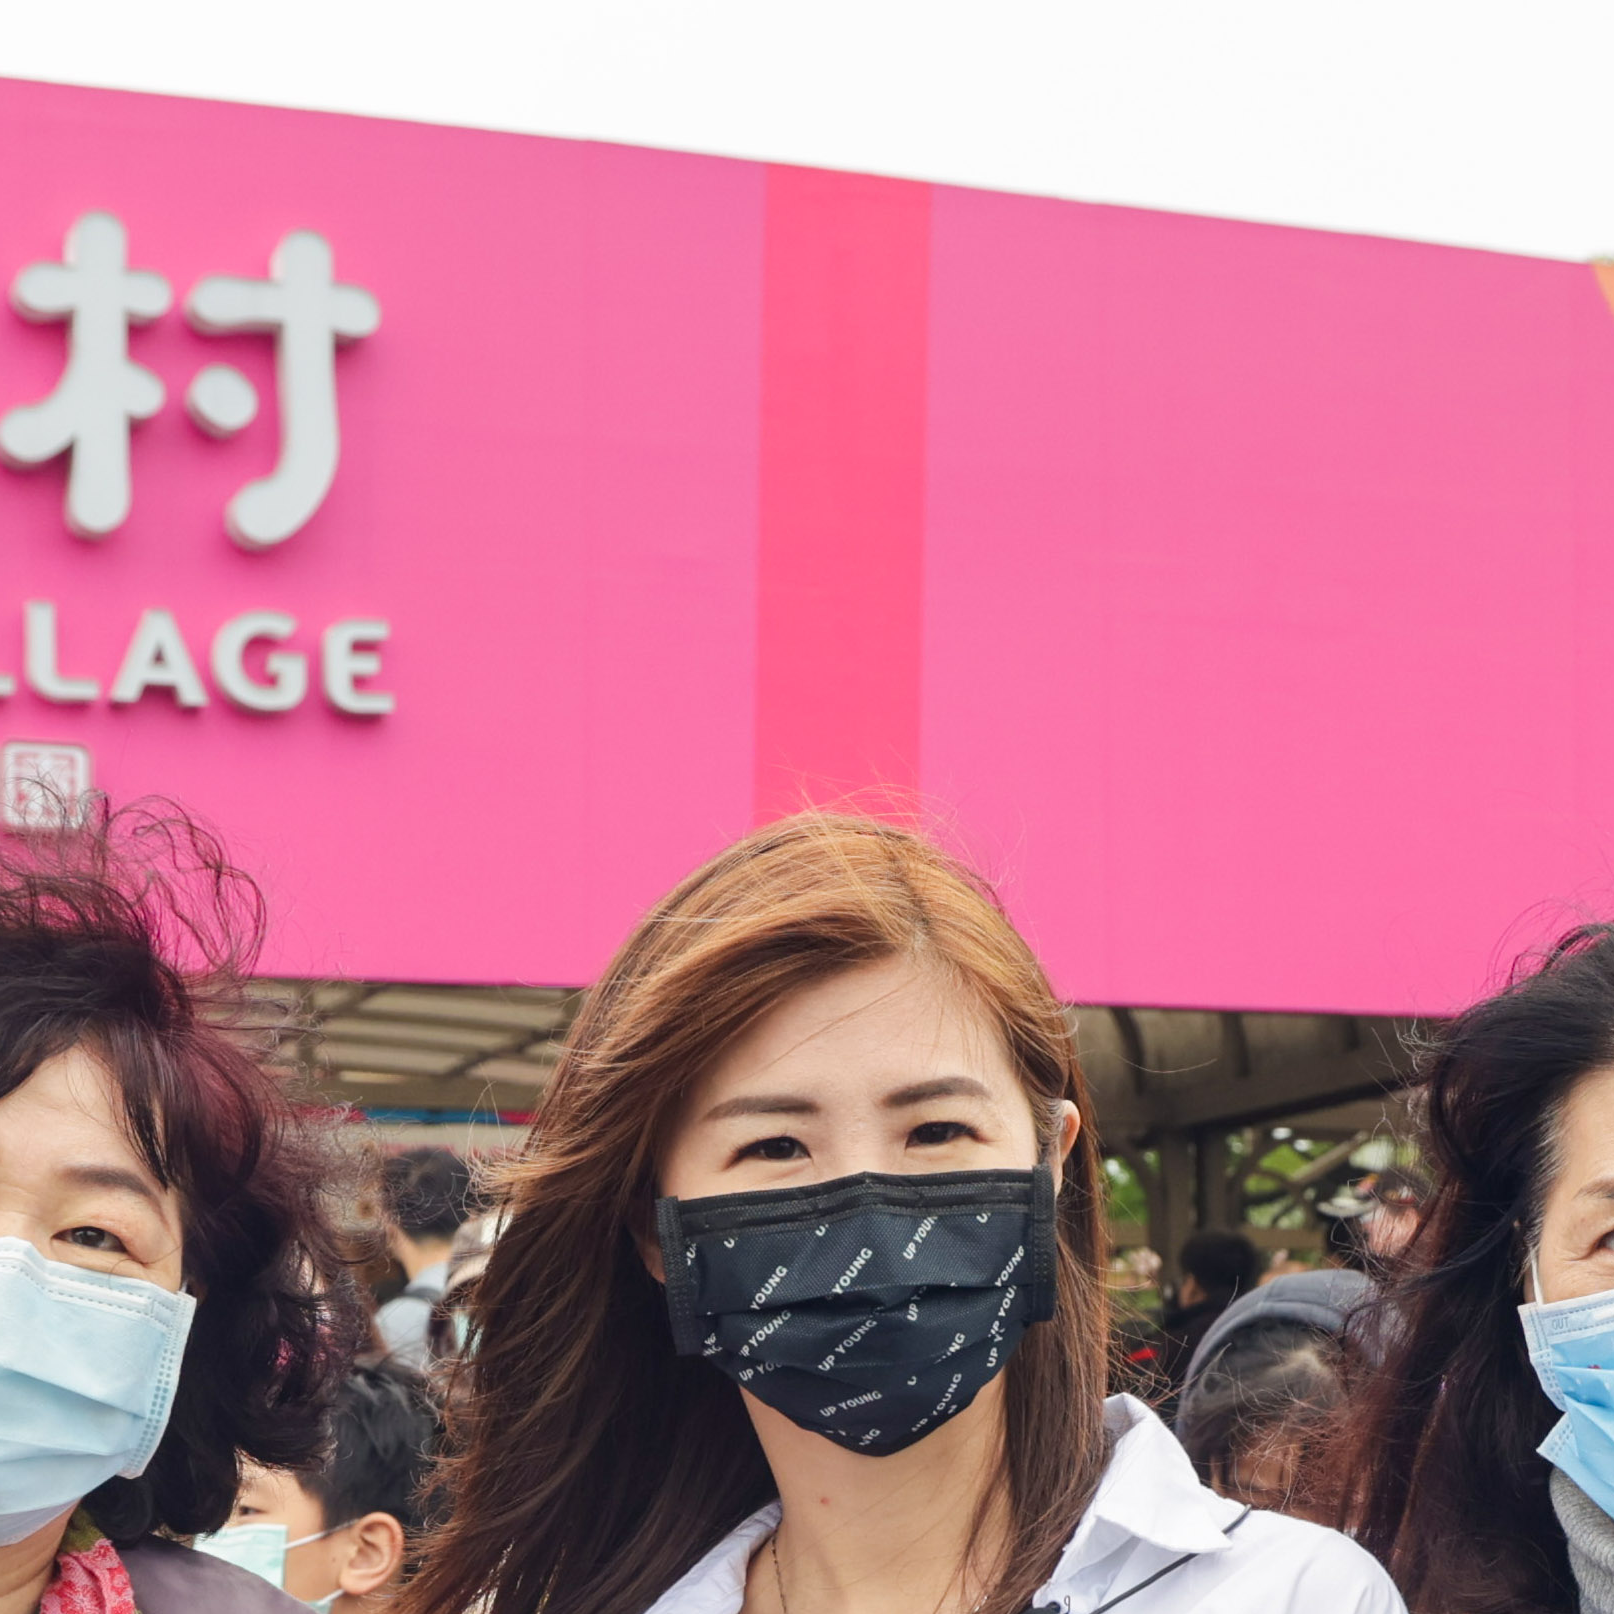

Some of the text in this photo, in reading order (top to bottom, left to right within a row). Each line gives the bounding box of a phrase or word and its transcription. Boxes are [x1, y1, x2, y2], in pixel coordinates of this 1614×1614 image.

[903, 1242, 917, 1260] UP
[831, 1247, 873, 1295] YOUNG
[750, 1265, 787, 1312] YOUNG
[749, 1309, 792, 1347] YOUNG
[1551, 1317, 1569, 1330] OUT
[818, 1318, 877, 1372] UP YOUNG
[739, 1368, 755, 1382] UP
[820, 1390, 883, 1418] UP YOUNG
